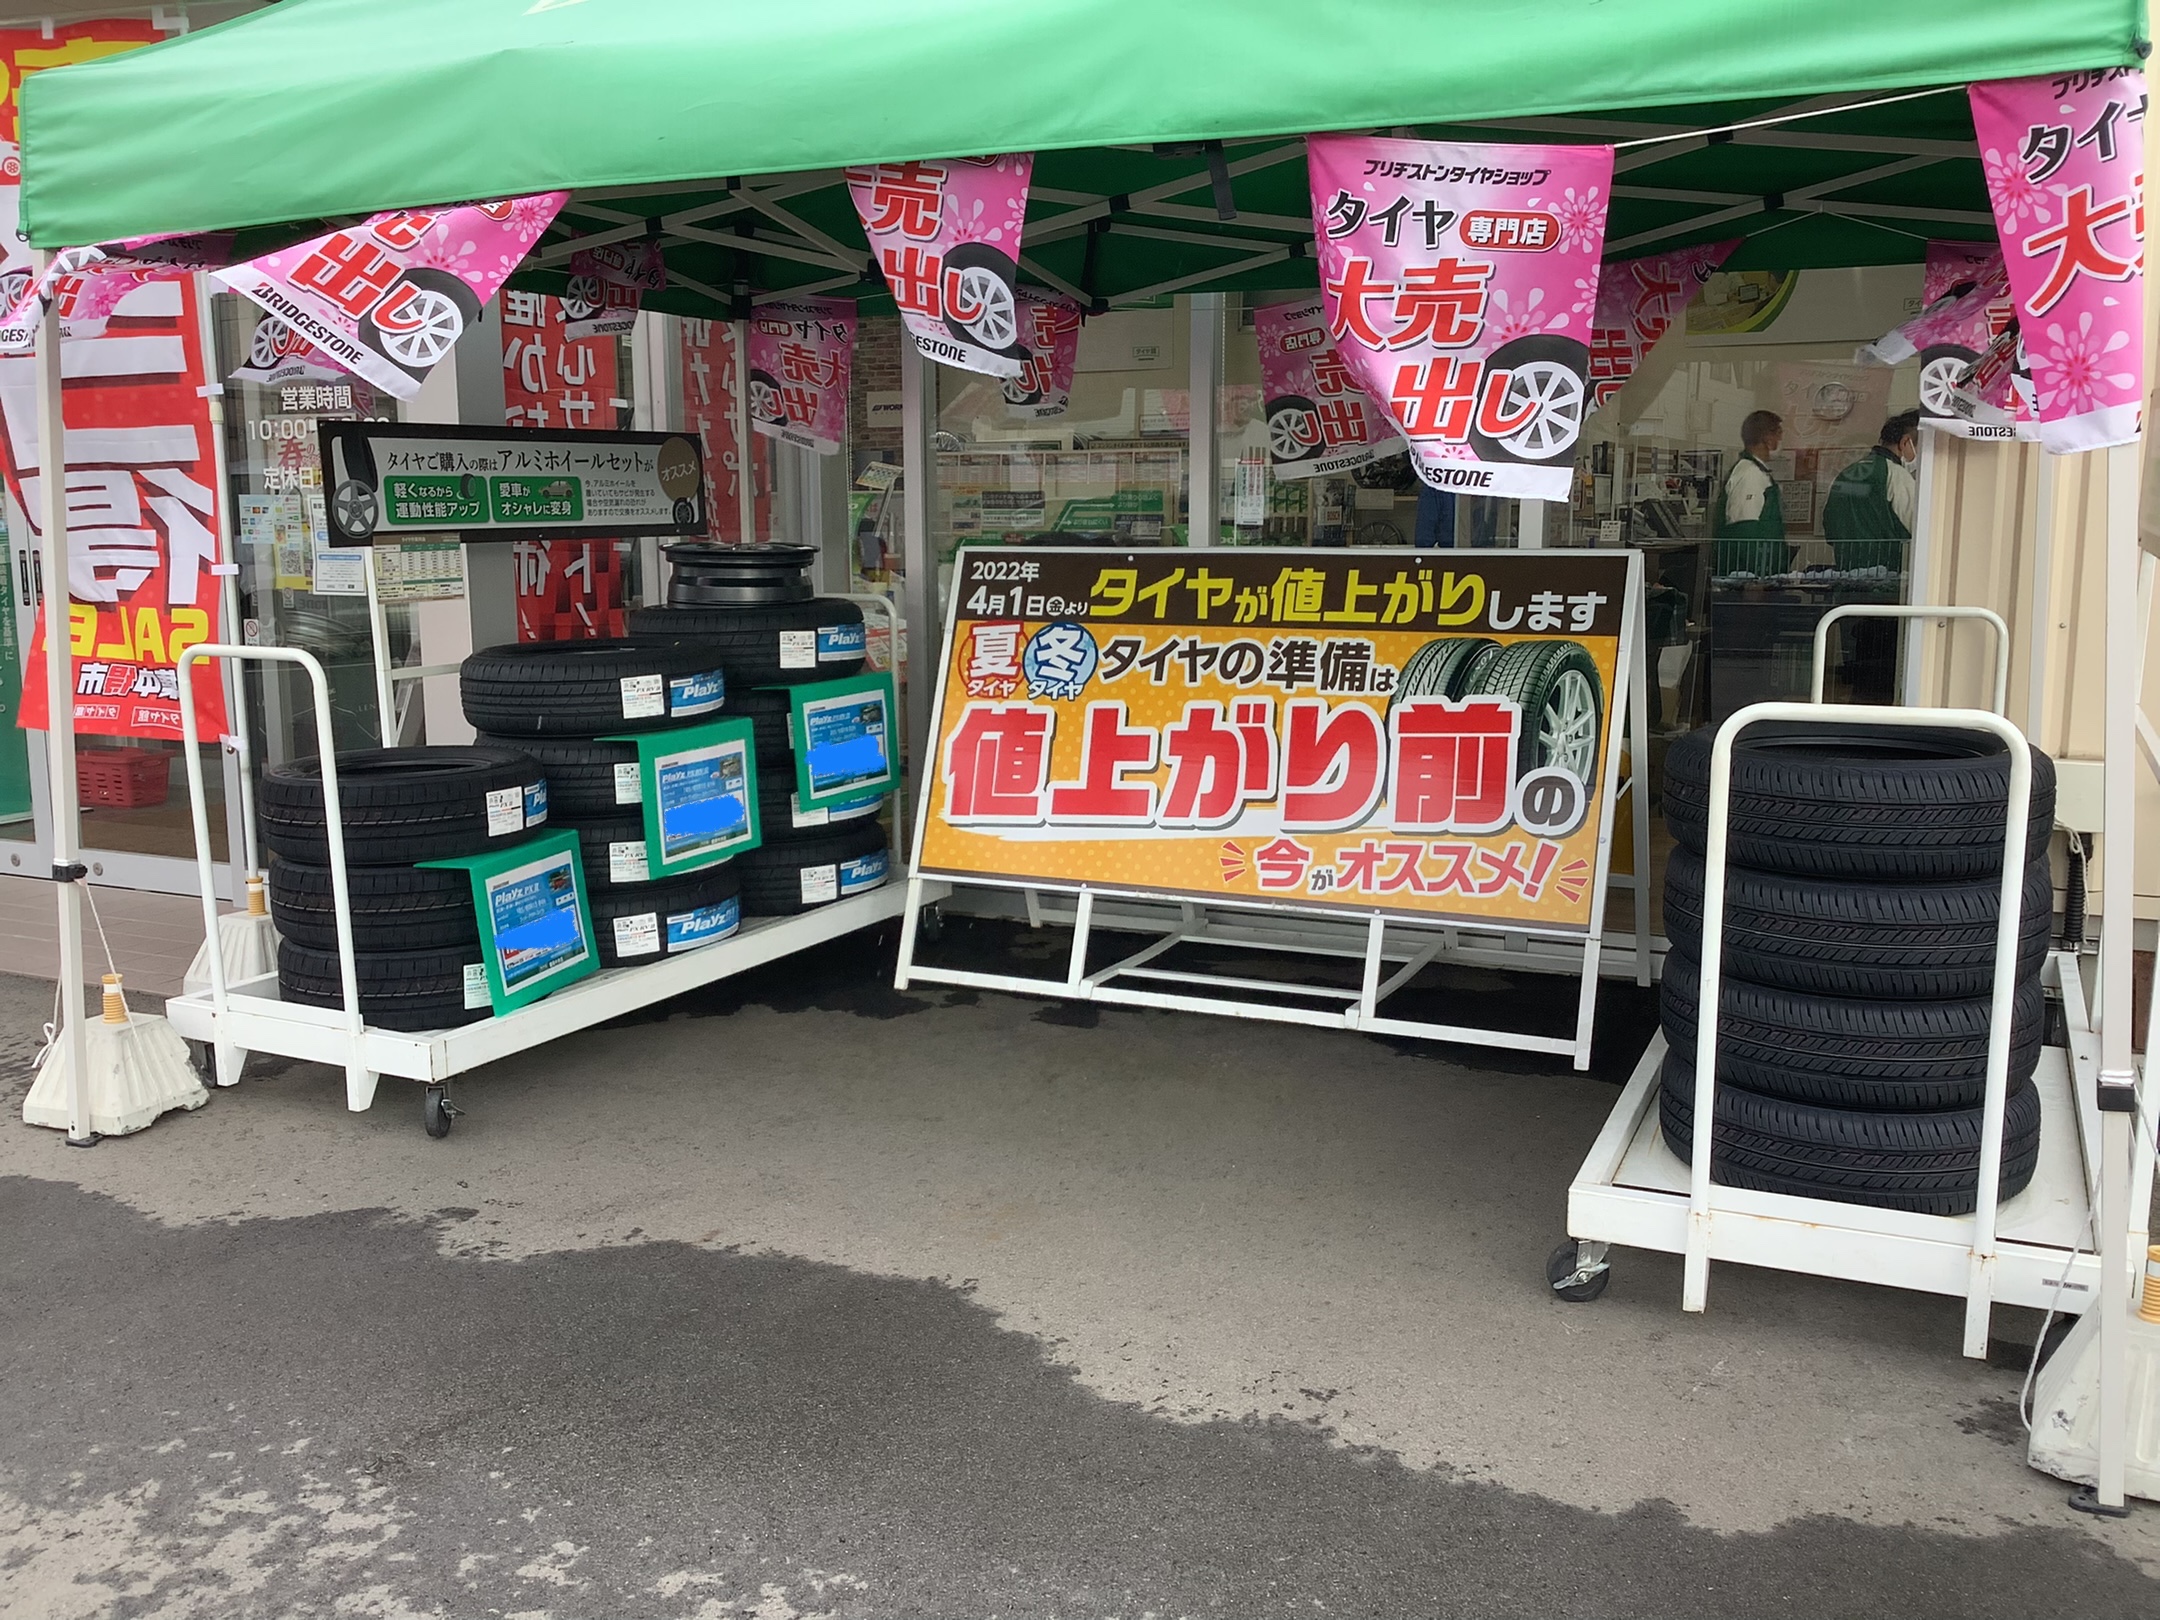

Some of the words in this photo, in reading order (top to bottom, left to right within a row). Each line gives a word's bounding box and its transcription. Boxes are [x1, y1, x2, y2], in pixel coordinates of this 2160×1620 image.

[1363, 158, 1552, 187] ブリヂストンタイヤショップ
[1327, 189, 1456, 249] タイヤ
[1467, 216, 1548, 246] 専門店
[2024, 178, 2145, 318] 大
[287, 232, 429, 335] 出し
[883, 246, 986, 323] 出し
[1326, 257, 1494, 350] 大売
[250, 282, 364, 366] BRIDGESTONE
[280, 385, 352, 411] 営業時間
[1389, 356, 1542, 443] 出し
[248, 418, 308, 441] 10:00
[387, 448, 654, 474] タイヤご購入の際はアルミホイールセットが
[660, 460, 697, 481] オススメ
[393, 481, 454, 499] 軽くなるから
[395, 500, 481, 518] 運動性能アップ
[499, 481, 532, 498] 愛車が
[500, 501, 573, 517] オシャレに変身
[970, 560, 1041, 583] 2022年
[1089, 566, 1607, 632] タイヤが値上がりします
[969, 623, 1021, 678] 夏
[1032, 624, 1087, 683] 冬
[1101, 636, 1398, 694] タイヤの準備は
[967, 679, 1017, 698] タイヤ
[1027, 681, 1085, 701] タイヤ
[946, 697, 1587, 833] 値上がり前の
[1257, 838, 1562, 900] 今がオススメ!
